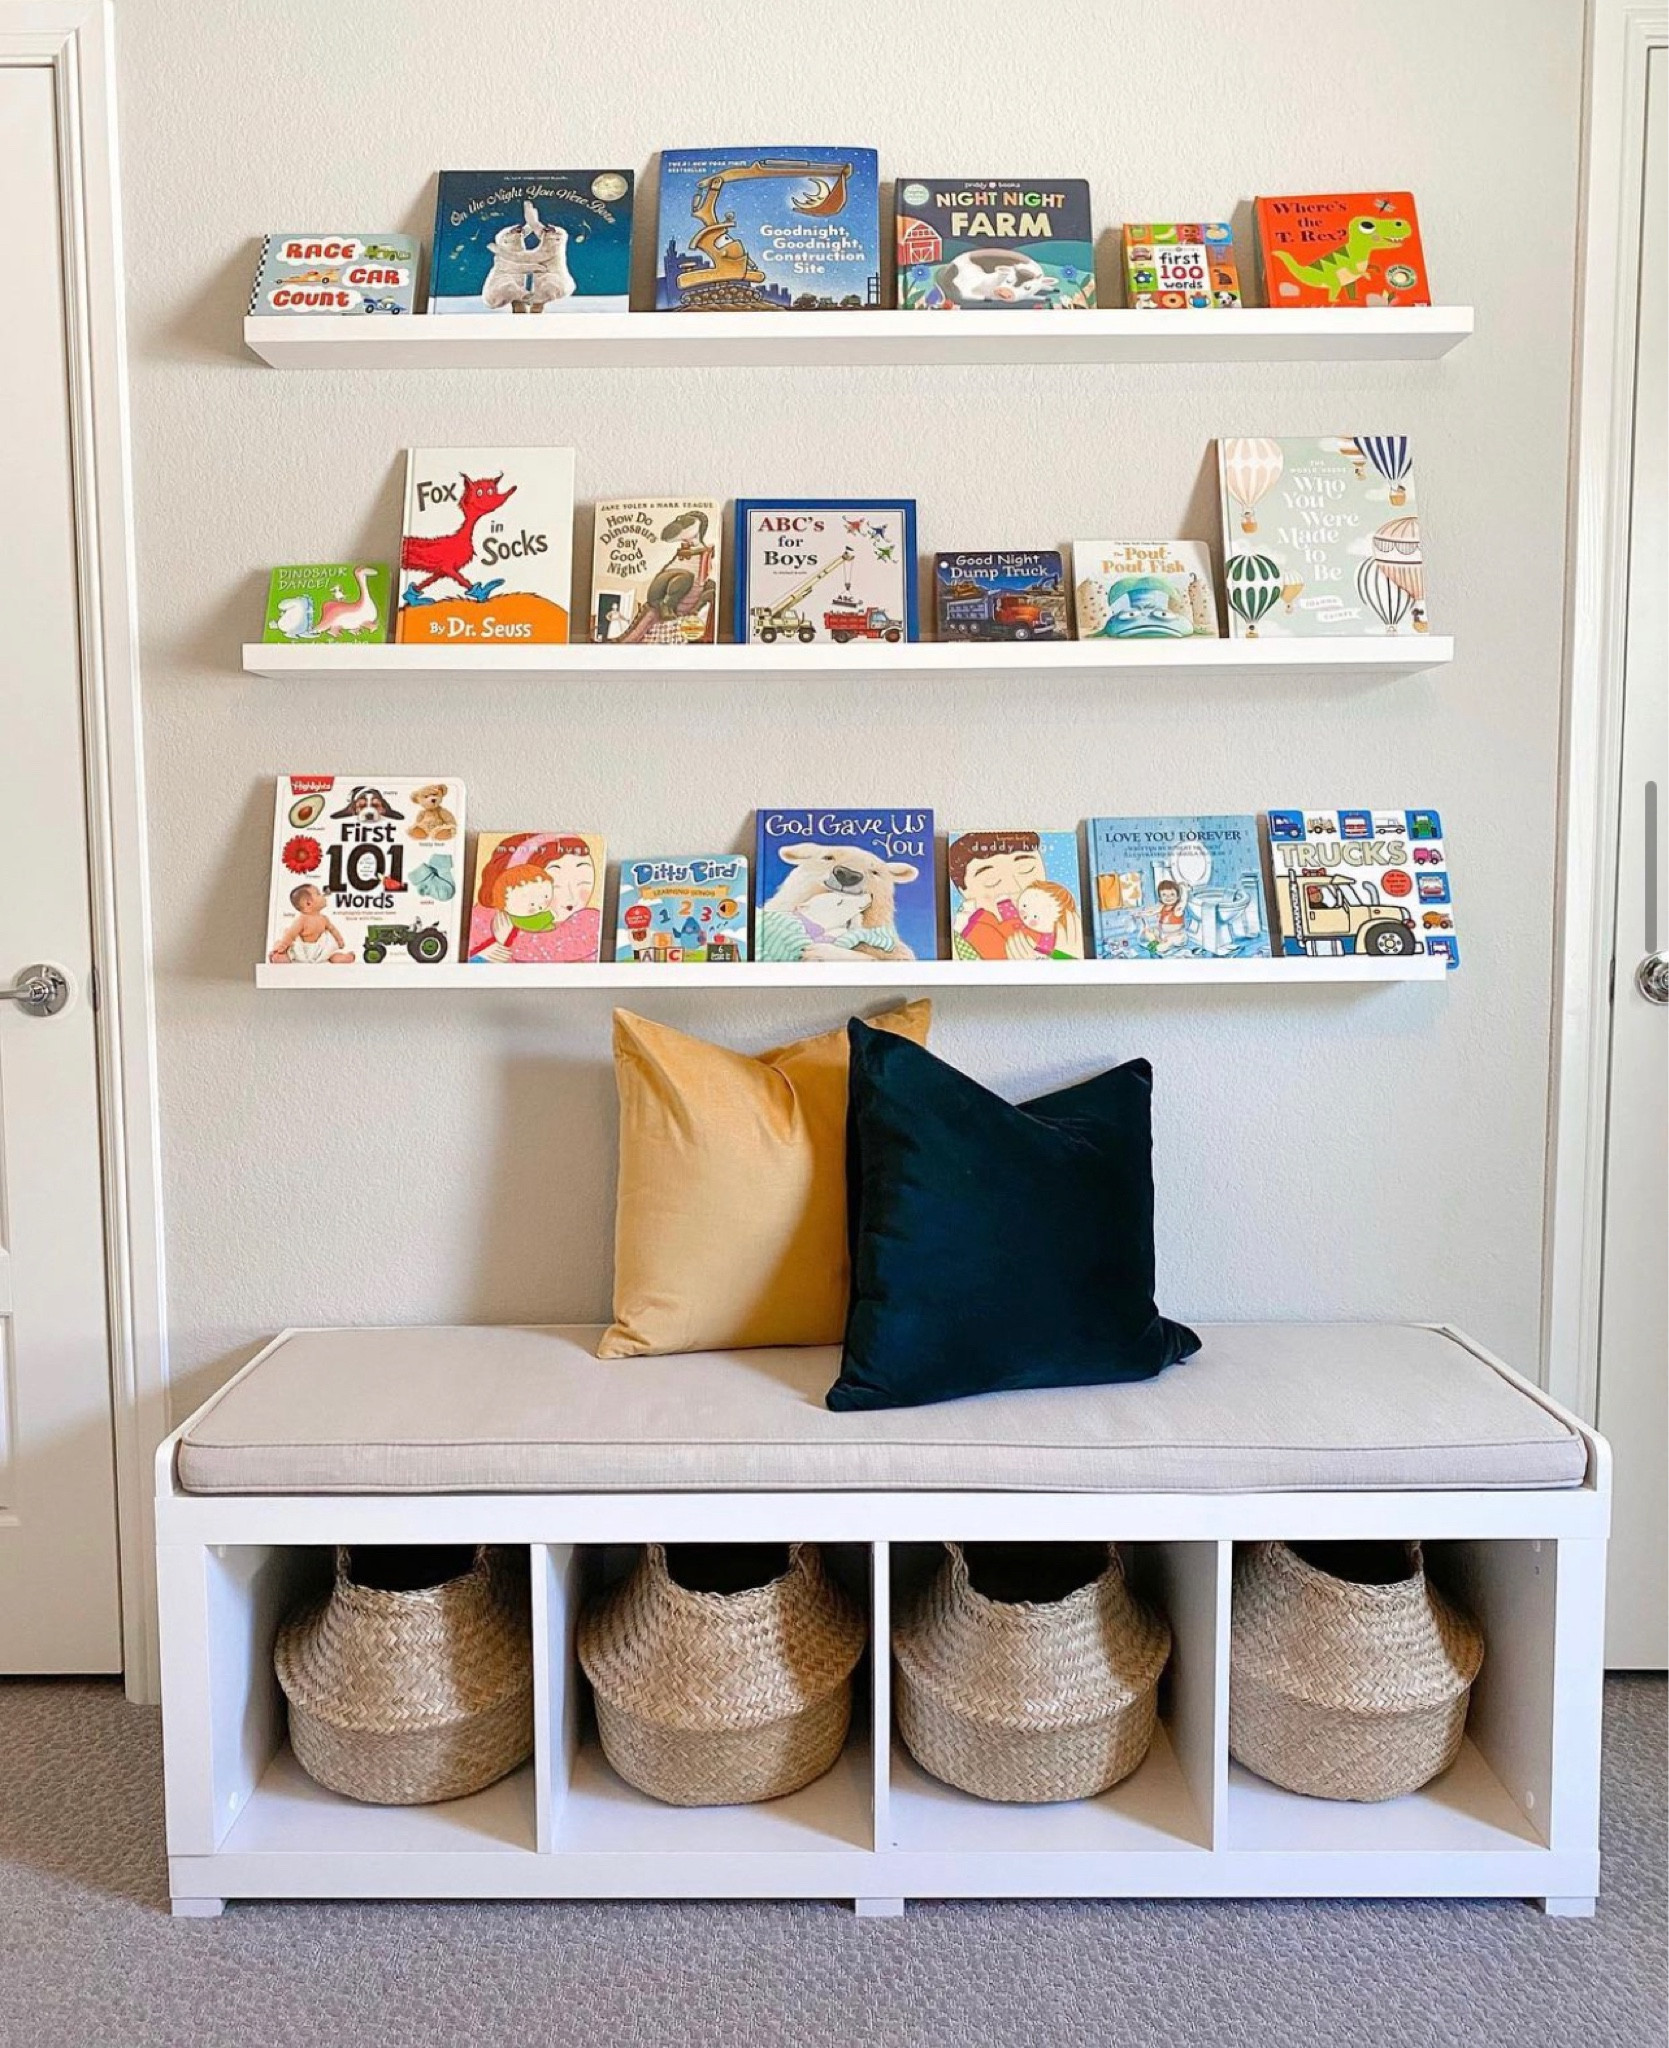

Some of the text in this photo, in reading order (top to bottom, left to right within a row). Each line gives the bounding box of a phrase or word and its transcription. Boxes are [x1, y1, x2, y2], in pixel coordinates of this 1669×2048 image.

[468, 198, 486, 213] the
[486, 186, 522, 204] Night
[525, 184, 554, 200] You
[555, 188, 588, 206] Were
[586, 200, 616, 224] Born
[935, 191, 998, 208] NIGHT
[1002, 192, 1065, 209] NIGHT
[1272, 201, 1347, 214] Where's
[951, 212, 1053, 237] FARM
[1297, 217, 1323, 228] the
[760, 224, 850, 239] Goodnight,
[1275, 229, 1347, 243] T. Rex?
[286, 243, 355, 259] RACE
[772, 237, 863, 251] Goodnight,
[762, 249, 865, 262] Construction
[1159, 252, 1200, 265] first
[793, 262, 826, 274] Site
[1161, 265, 1204, 279] 100
[349, 268, 400, 285] CAR
[1163, 279, 1204, 289] words
[416, 480, 458, 512] Fox
[1294, 476, 1346, 500] Who
[1282, 491, 1325, 509] You
[490, 520, 504, 533] in
[606, 512, 653, 528] How Do
[758, 516, 825, 532] ABC's
[1300, 511, 1360, 527] Were
[599, 525, 657, 545] Dinosaurs
[778, 535, 804, 548] for
[1277, 527, 1340, 550] Made
[480, 529, 548, 566] Socks
[616, 537, 638, 550] Say
[610, 547, 643, 562] Good
[763, 550, 818, 569] Boys
[955, 553, 1040, 567] Good Night
[280, 567, 348, 579] DINOSAUR
[607, 560, 647, 578] Night?
[950, 564, 1049, 581] Dump Truck
[1101, 560, 1185, 574] Pout Fish
[1314, 564, 1343, 582] Be
[429, 616, 532, 638] By Dr. Seuss
[341, 823, 396, 842] First
[765, 813, 813, 837] God
[818, 814, 887, 836] Gave
[1105, 830, 1242, 843] LOVE YOU FOREVER
[872, 832, 925, 858] You
[971, 841, 1014, 852] daddy
[1277, 840, 1408, 867] TRUCKS
[323, 843, 408, 893] 101
[633, 860, 738, 884] Ditty Bird
[336, 892, 394, 909] Words
[679, 901, 692, 915] 2
[659, 909, 671, 923] 1
[701, 906, 713, 921] 3
